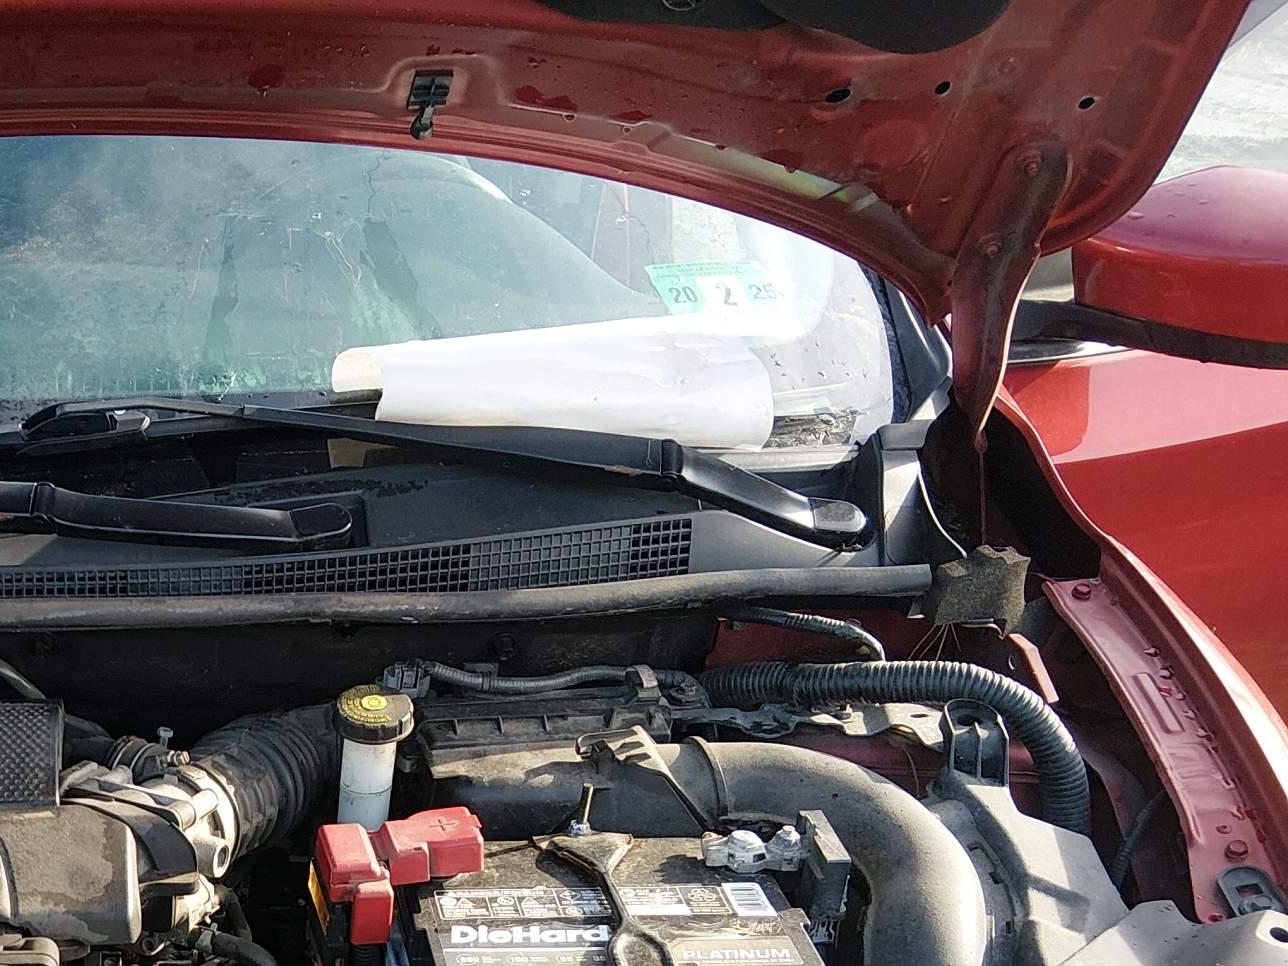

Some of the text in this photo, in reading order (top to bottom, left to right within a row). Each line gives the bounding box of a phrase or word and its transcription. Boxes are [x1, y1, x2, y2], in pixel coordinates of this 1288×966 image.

[668, 286, 698, 303] 20
[715, 282, 738, 306] 2
[450, 925, 609, 943] DieHard
[683, 948, 791, 960] PLATINUM
